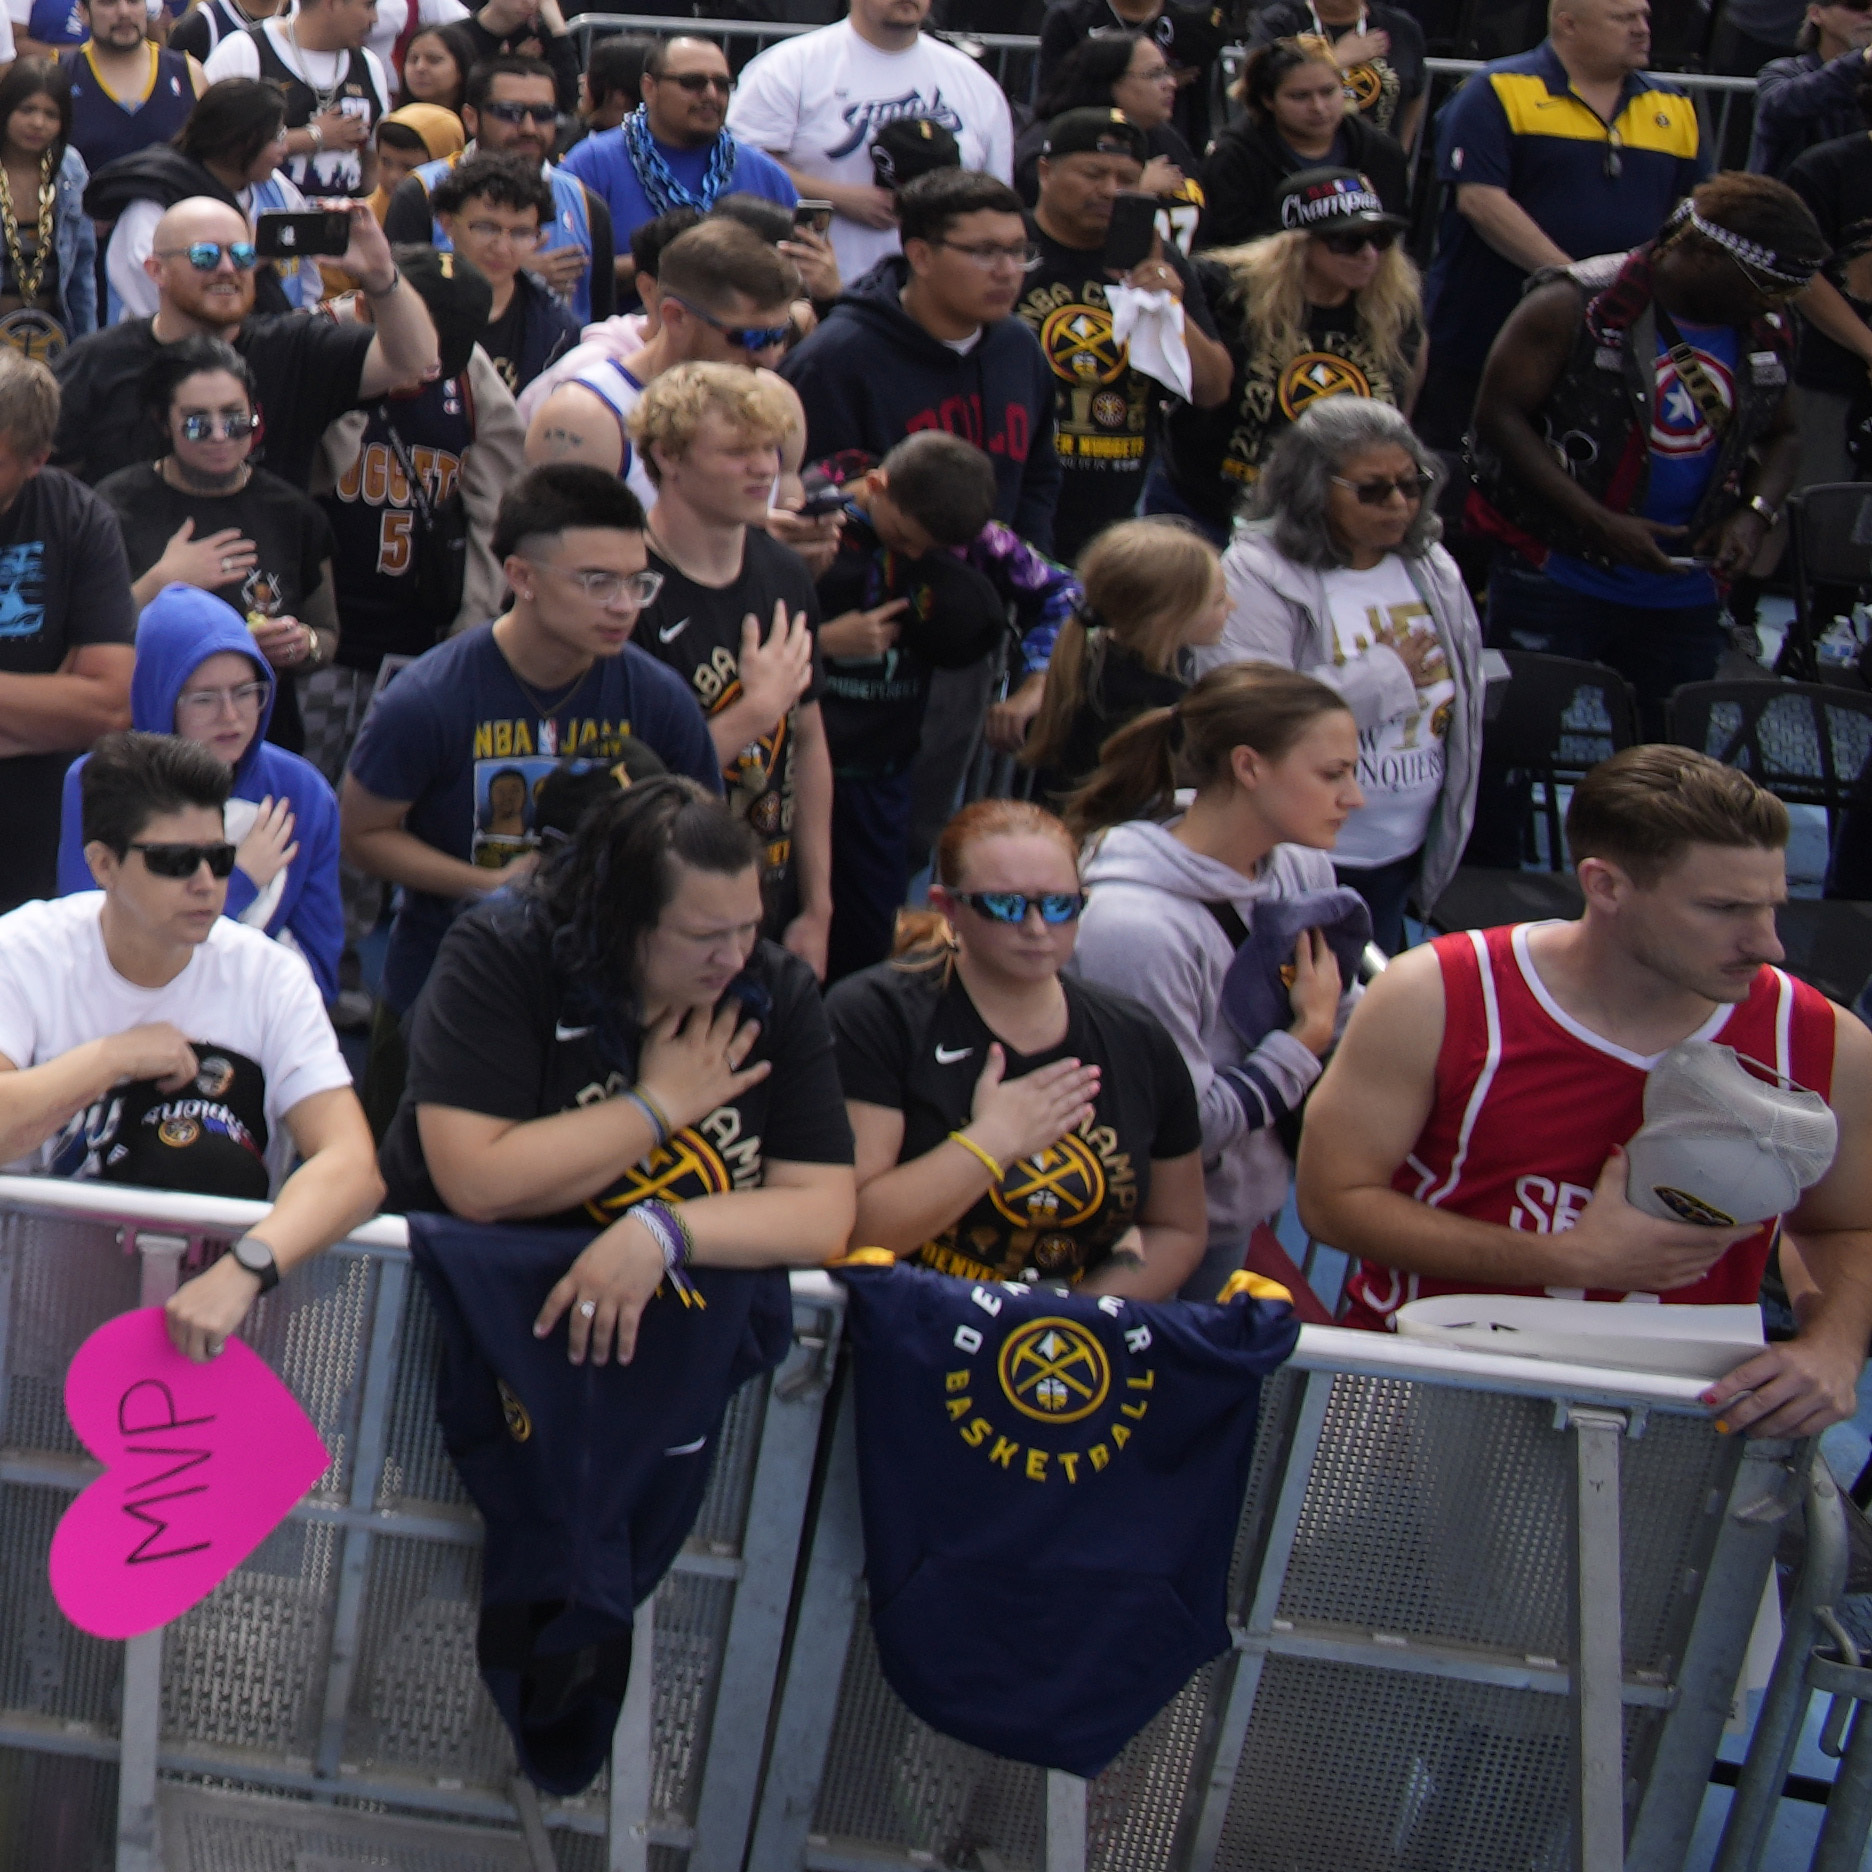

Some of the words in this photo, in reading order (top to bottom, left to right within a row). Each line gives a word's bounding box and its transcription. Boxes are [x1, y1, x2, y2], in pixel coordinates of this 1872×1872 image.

[376, 509, 415, 577] 5
[474, 719, 534, 759] NBA
[119, 1378, 217, 1566] MVP
[945, 1366, 1155, 1485] BASKETBALL
